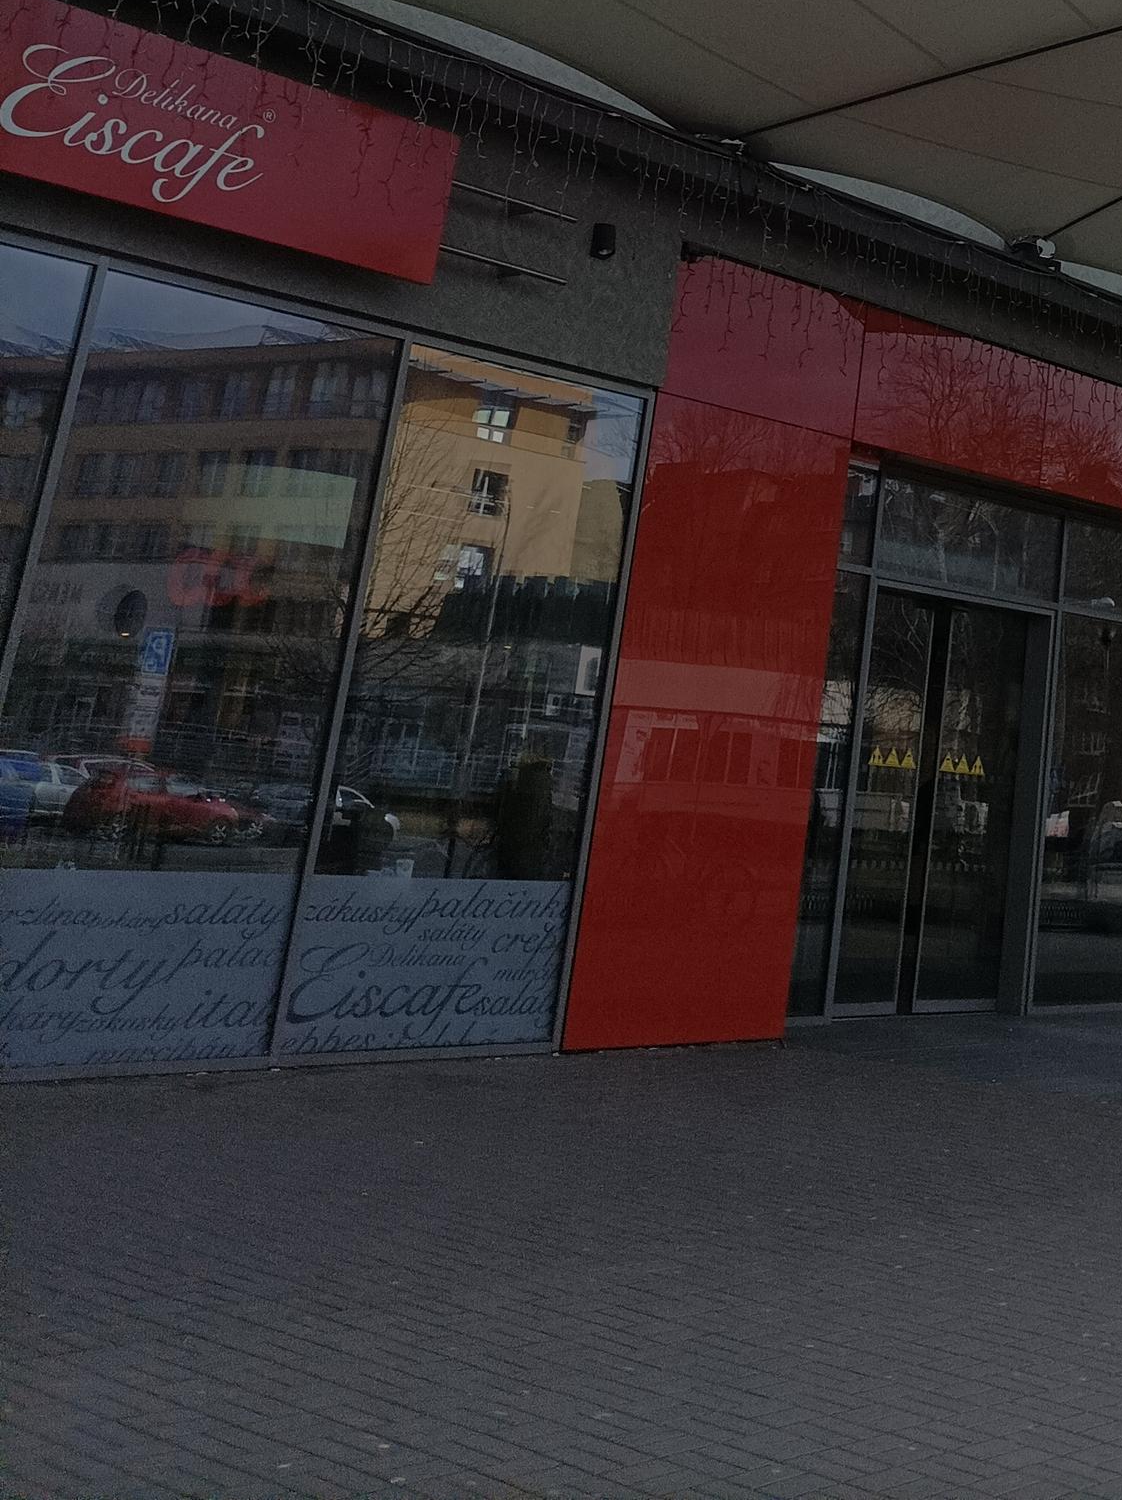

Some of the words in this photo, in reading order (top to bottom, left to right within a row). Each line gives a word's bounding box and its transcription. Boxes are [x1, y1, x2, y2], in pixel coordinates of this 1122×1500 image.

[0, 43, 265, 202] Eiscafe
[112, 68, 241, 130] Delikana
[286, 941, 488, 1039] Eiscafe
